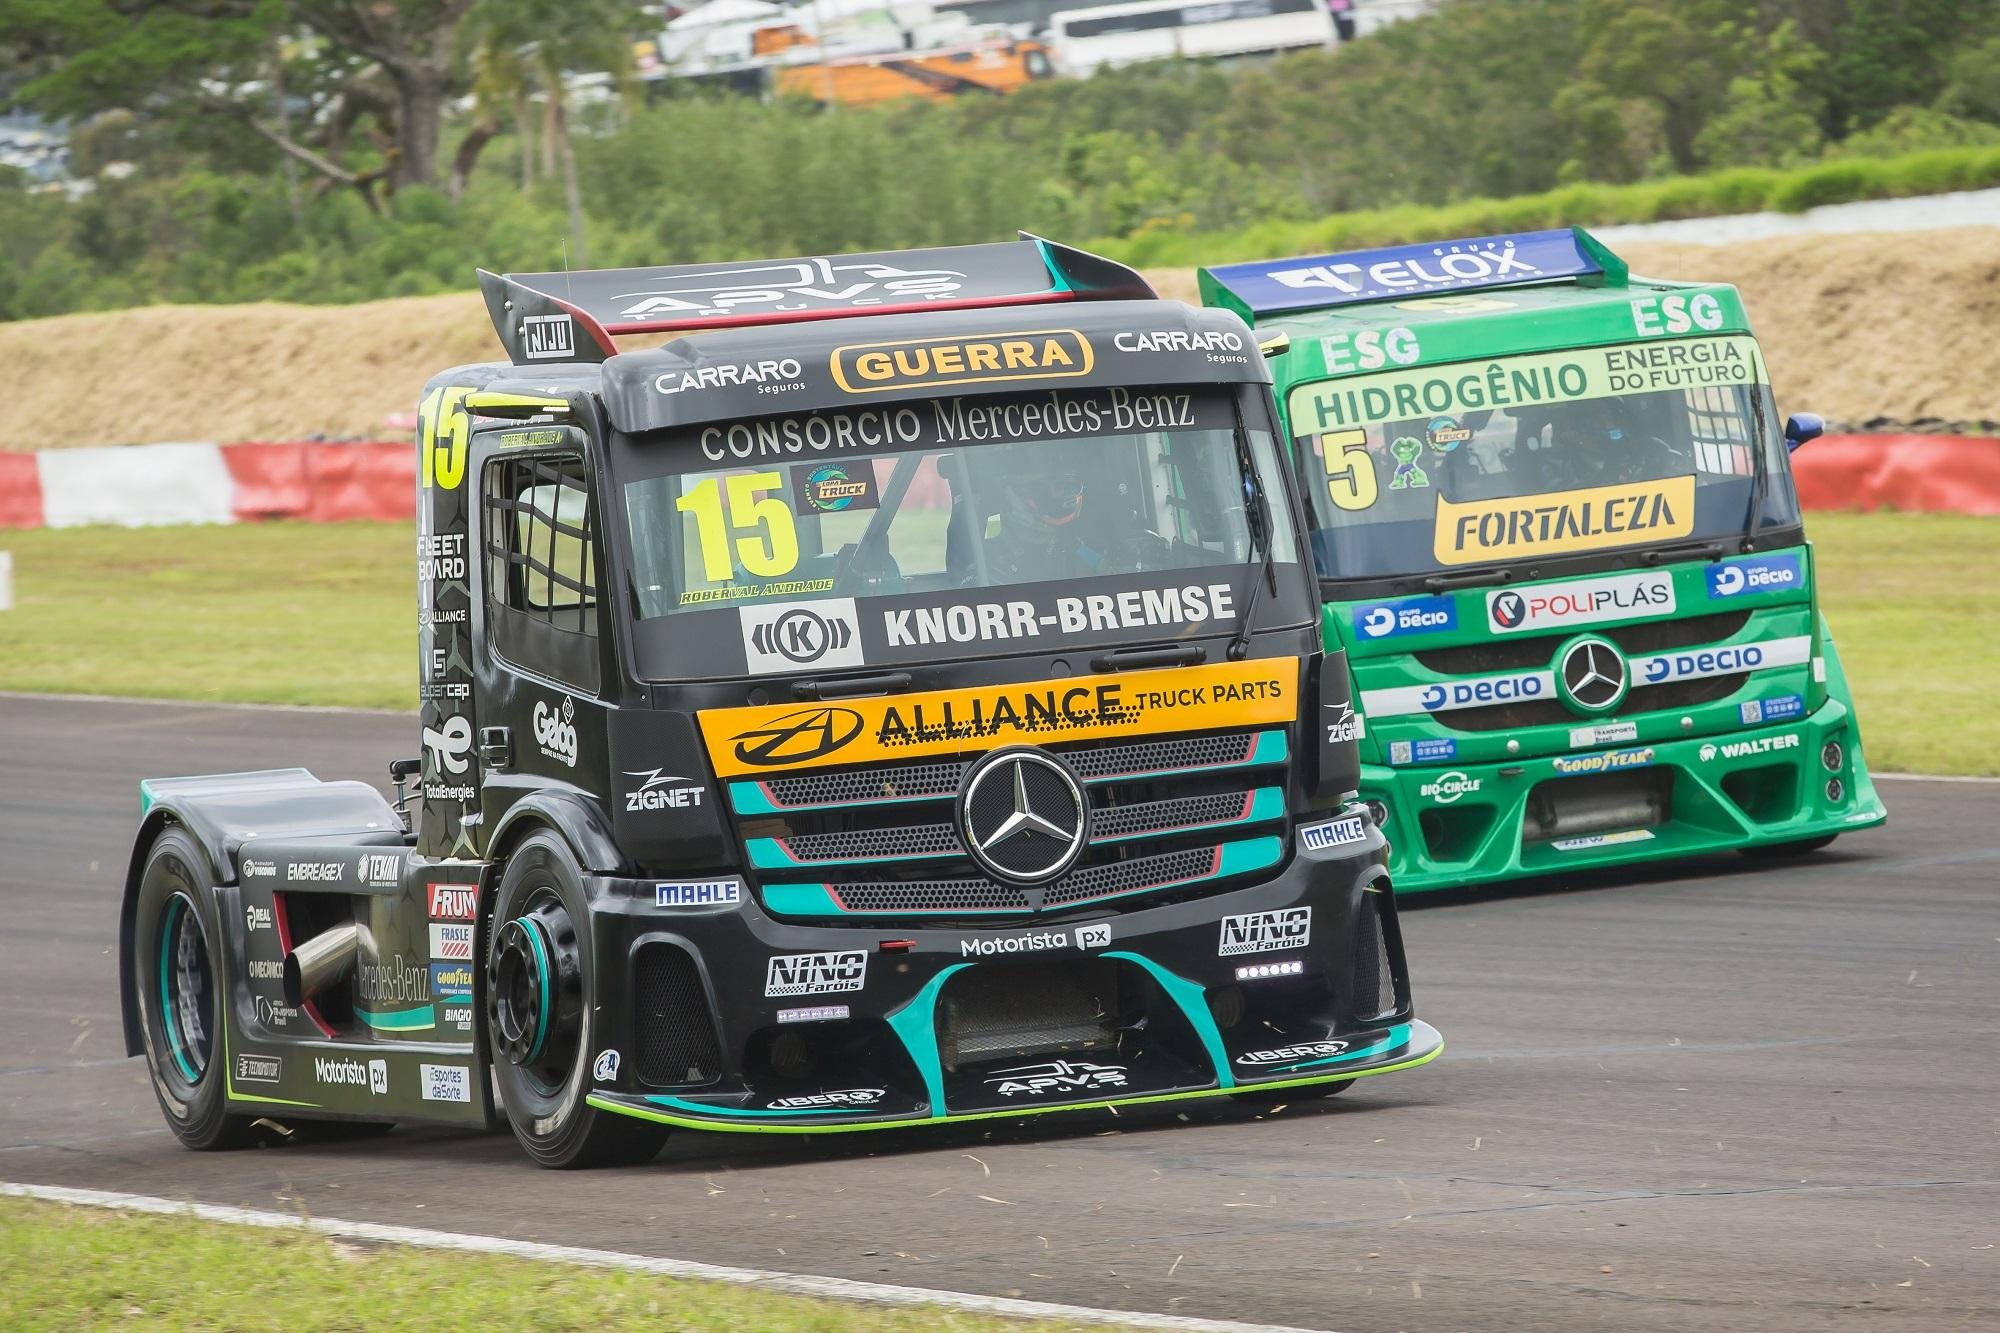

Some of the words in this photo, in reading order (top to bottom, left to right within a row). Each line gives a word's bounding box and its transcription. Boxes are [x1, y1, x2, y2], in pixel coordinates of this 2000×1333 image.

[1433, 240, 1516, 256] GRUPO
[1635, 293, 1724, 337] ESG
[1113, 331, 1243, 352] CARRARO
[1320, 327, 1421, 375] ESG
[855, 339, 1074, 381] GUERRA
[1206, 353, 1248, 364] Seguros
[1605, 341, 1742, 372] ENERGIA
[655, 358, 801, 395] CARRARO
[757, 381, 806, 395] Seguros
[1609, 373, 1644, 392] DO
[1649, 364, 1746, 387] FUTURO
[1314, 363, 1588, 428] HIDROGÊNIO
[930, 387, 1195, 443] Mercedes-Benz
[419, 387, 478, 489] 15
[1321, 429, 1378, 511] 5
[822, 485, 862, 497] TRUCK
[676, 471, 799, 582] 15
[1455, 493, 1675, 551] FORTALEZA
[418, 534, 464, 556] FLEET
[418, 557, 465, 579] BOARD
[681, 585, 758, 603] ROBERVAL
[761, 579, 833, 596] ANDRADE
[1529, 583, 1669, 618] POLIPLÁS
[884, 584, 1236, 647] KNORR-BREMSE
[877, 684, 1127, 745] ALLIANCE
[1136, 688, 1206, 711] TRUCK
[1213, 680, 1282, 701] PARTS
[1720, 734, 1800, 758] WALTER
[1562, 751, 1647, 772] GOODYEAR
[425, 784, 475, 802] TotalEnergies
[625, 787, 705, 811] ZIGNET
[1420, 780, 1481, 796] BIO-CIRCLE
[1304, 821, 1363, 846] MAHLE
[287, 863, 345, 881] EMBREAGEX
[658, 883, 737, 904] MAHLE
[256, 909, 271, 921] REAL
[960, 932, 1068, 957] Motorista
[1255, 938, 1305, 951] Faróis
[437, 968, 473, 987] GOODYEA
[805, 980, 859, 993] Faróis
[445, 1009, 472, 1022] BIAGIO
[315, 1057, 366, 1086] Motorista
